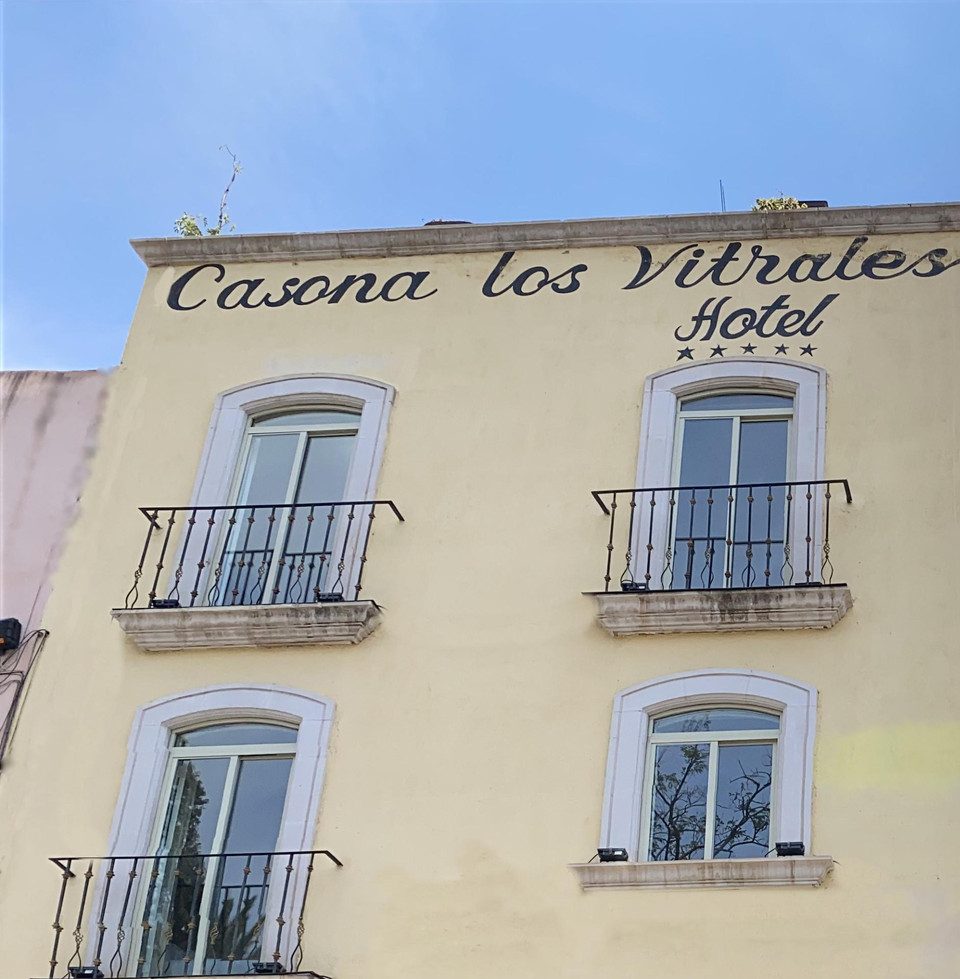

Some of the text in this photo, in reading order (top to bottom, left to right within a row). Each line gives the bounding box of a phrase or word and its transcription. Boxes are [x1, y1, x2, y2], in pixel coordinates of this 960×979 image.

[167, 263, 438, 311] Casona
[481, 251, 588, 298] los
[674, 293, 840, 341] Hotel
